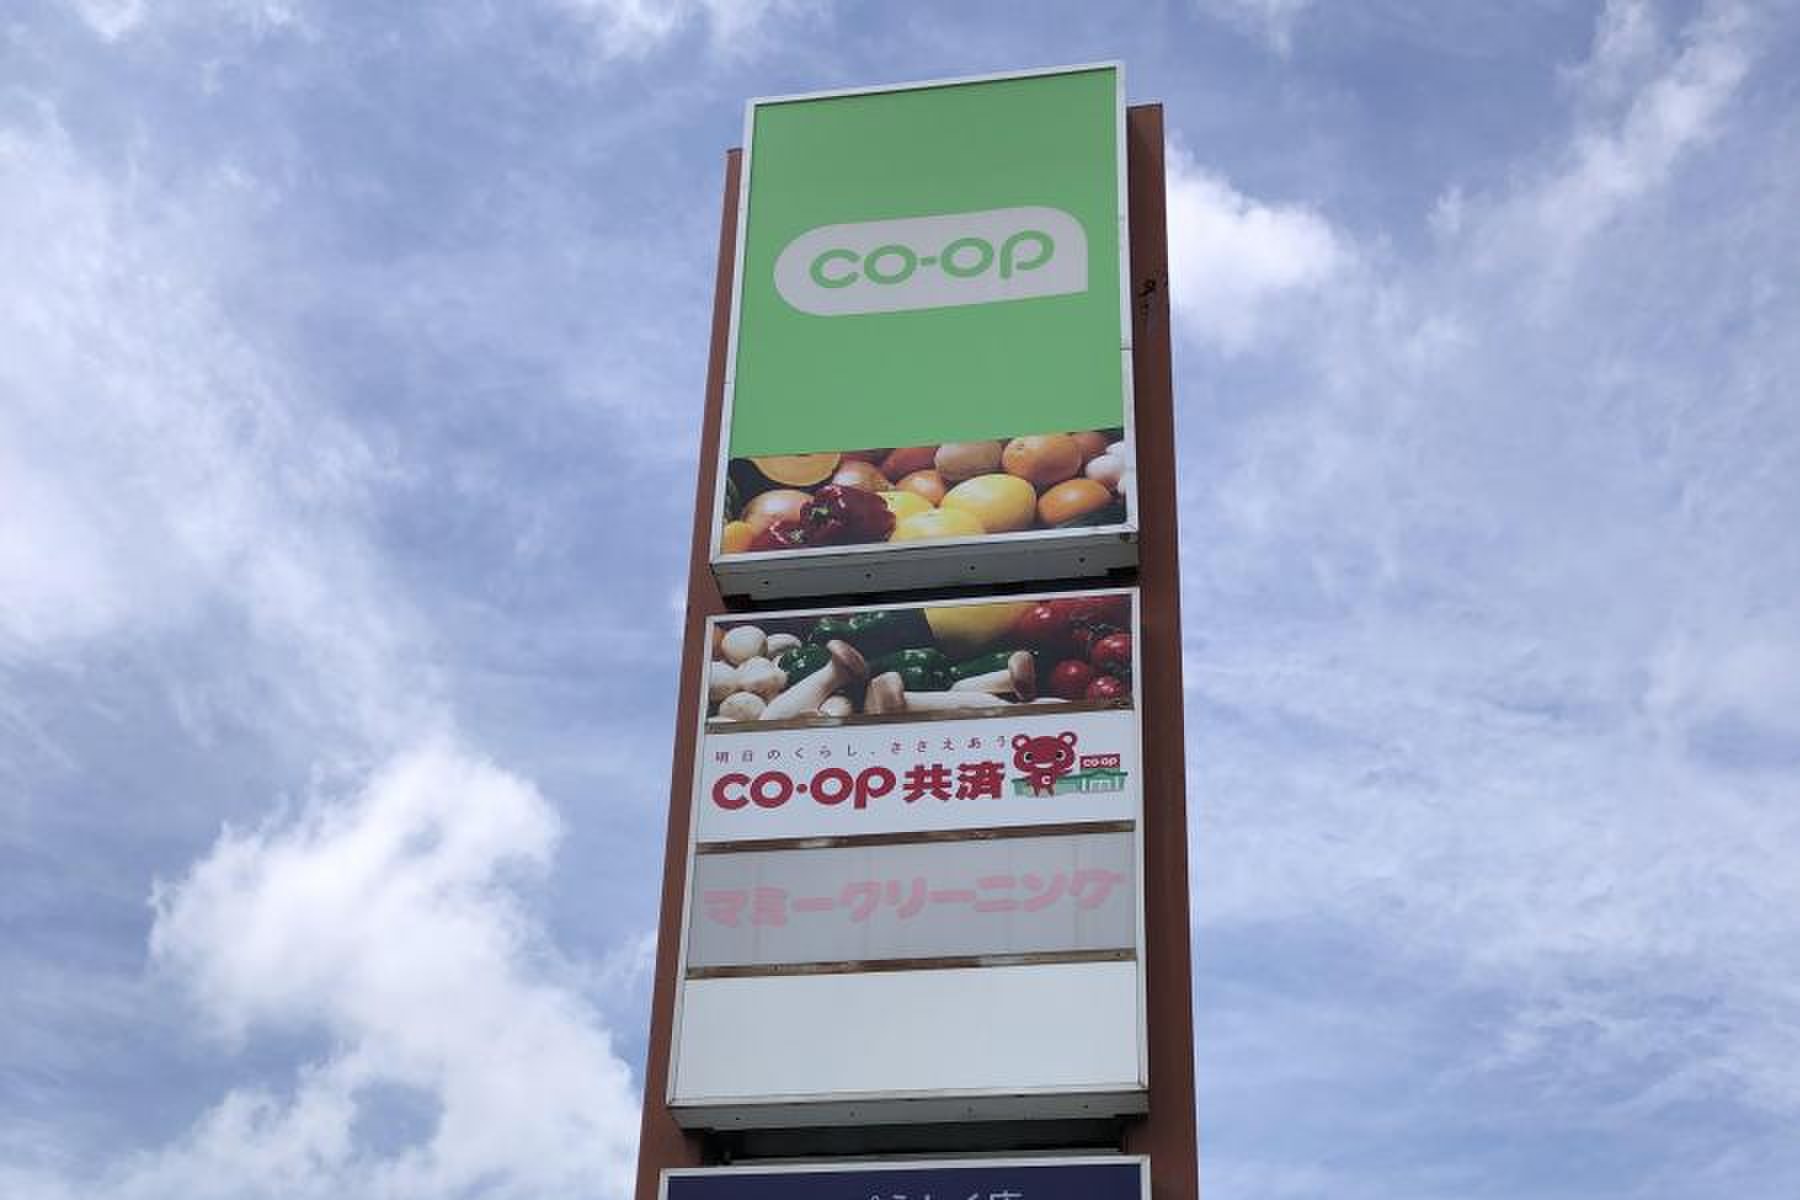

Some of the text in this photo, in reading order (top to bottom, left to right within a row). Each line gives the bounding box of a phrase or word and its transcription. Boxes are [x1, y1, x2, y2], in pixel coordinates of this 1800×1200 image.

[703, 867, 1127, 929] マミークリーニング
